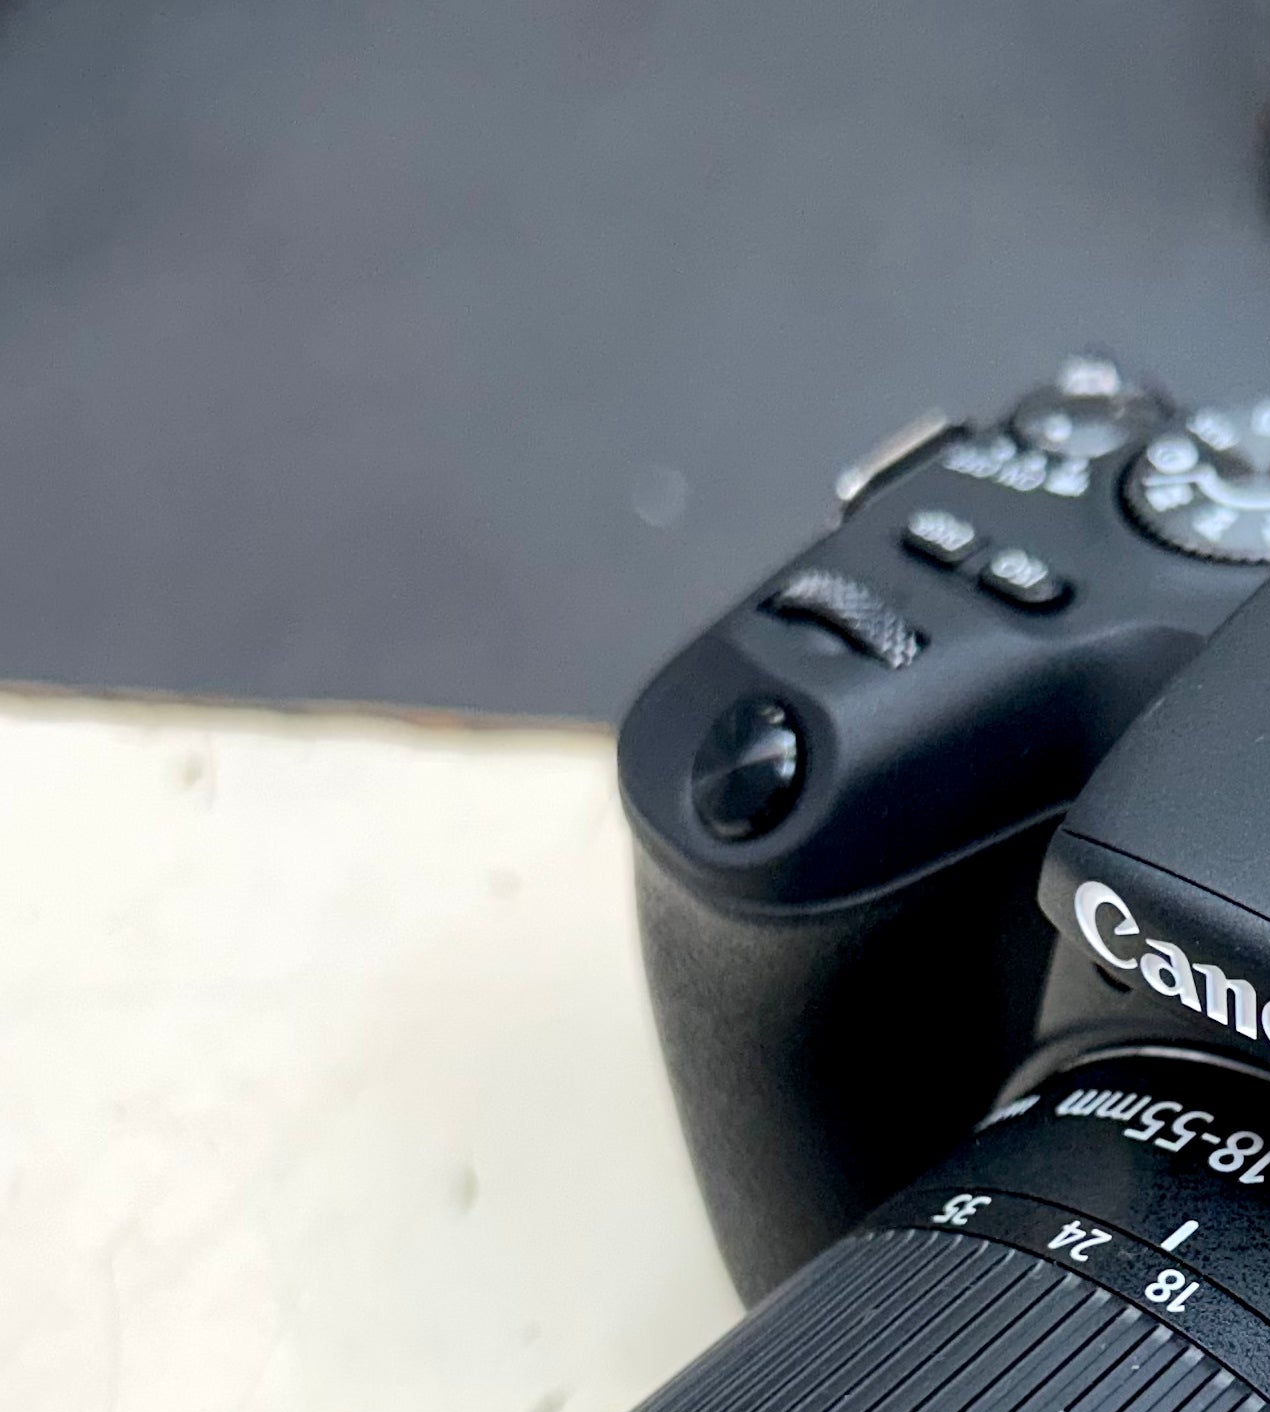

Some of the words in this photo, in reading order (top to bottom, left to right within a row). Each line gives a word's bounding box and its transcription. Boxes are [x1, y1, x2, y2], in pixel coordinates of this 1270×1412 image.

[931, 1193, 992, 1226] 35
[1047, 1219, 1113, 1262] 24
[1144, 1268, 1200, 1313] 18
